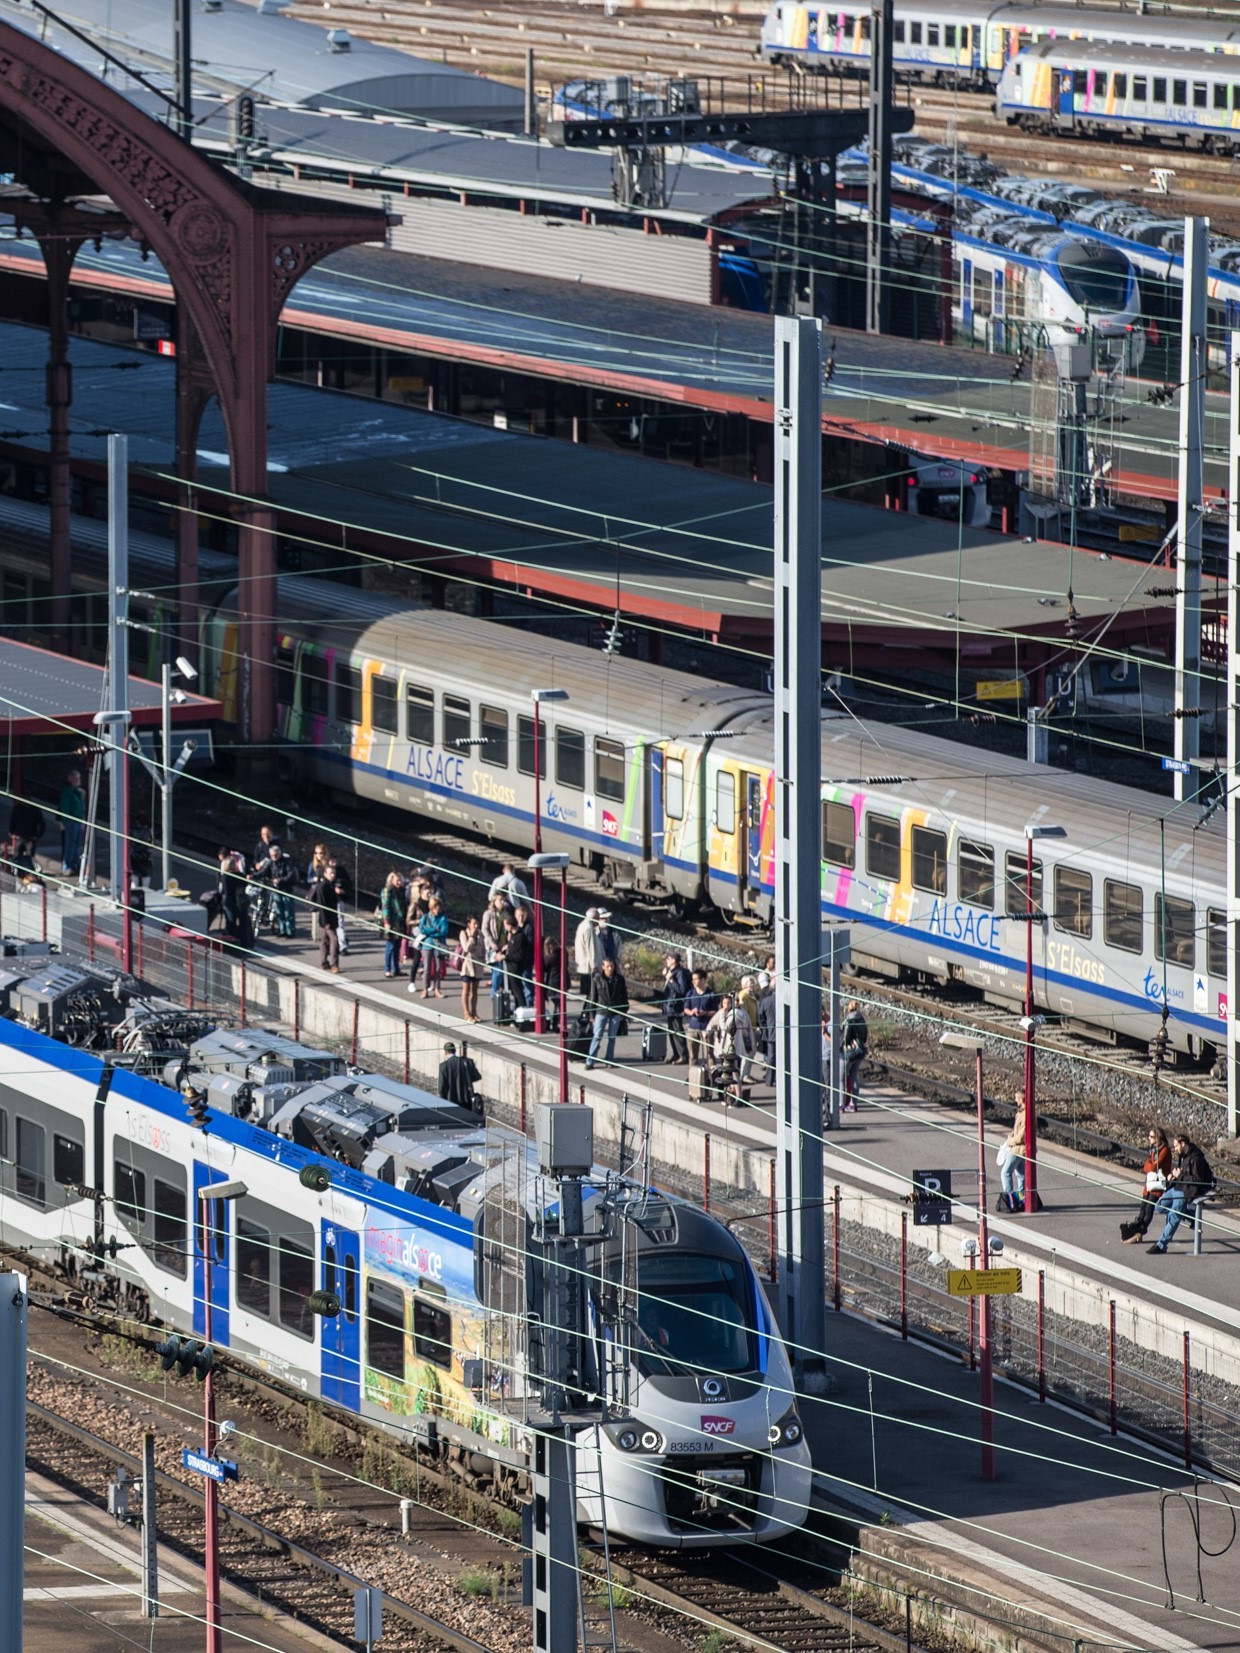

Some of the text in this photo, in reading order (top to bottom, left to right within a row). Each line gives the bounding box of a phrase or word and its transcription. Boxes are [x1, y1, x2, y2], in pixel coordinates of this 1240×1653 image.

[406, 744, 516, 807] ALSACE S'Elsass
[929, 899, 1105, 985] ALSACE S'Elsass
[940, 1213, 947, 1222] 4
[702, 1421, 734, 1433] SNCF
[670, 1442, 714, 1452] 83553 M
